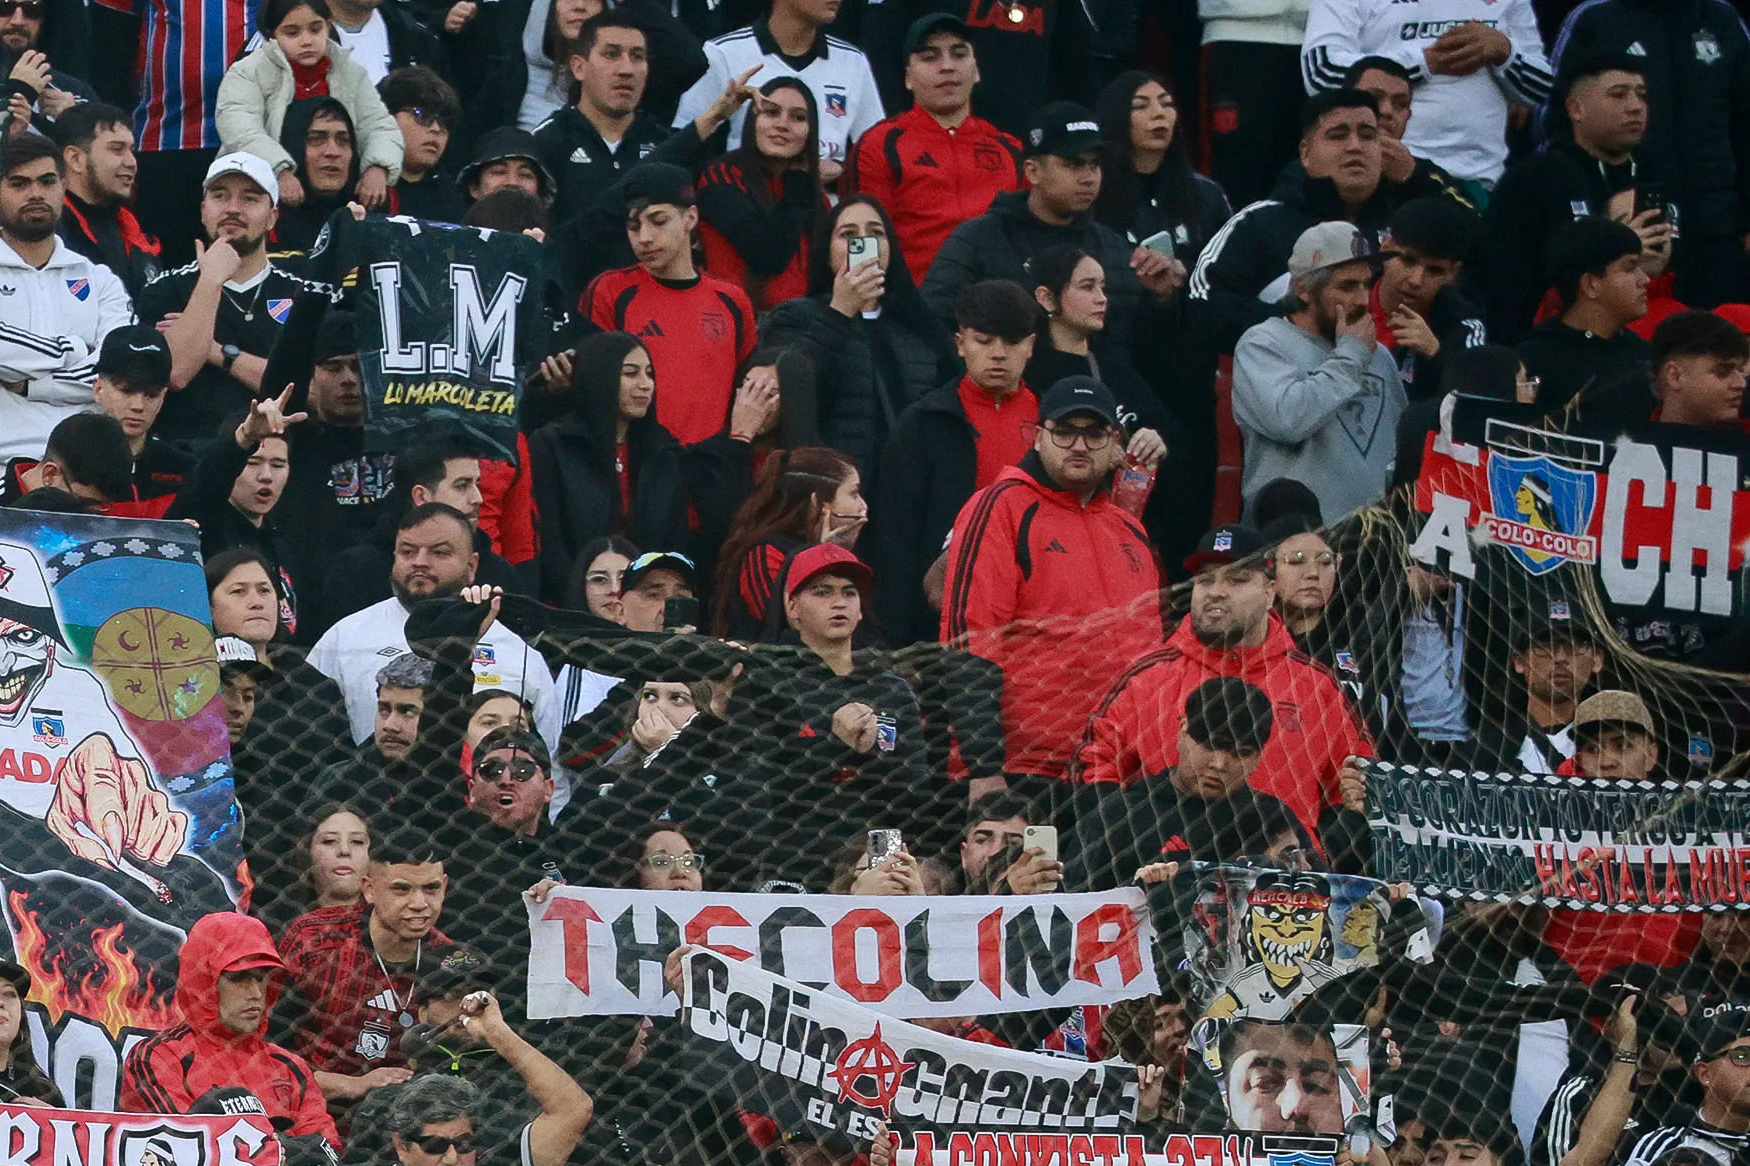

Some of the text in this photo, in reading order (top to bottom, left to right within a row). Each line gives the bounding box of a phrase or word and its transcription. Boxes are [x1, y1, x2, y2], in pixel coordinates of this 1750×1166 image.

[1486, 518, 1593, 563] COLO-COLO
[1534, 843, 1642, 905] HASTA
[1644, 845, 1686, 905] LA
[759, 903, 1144, 1003] COLINA
[807, 1097, 837, 1129] EL
